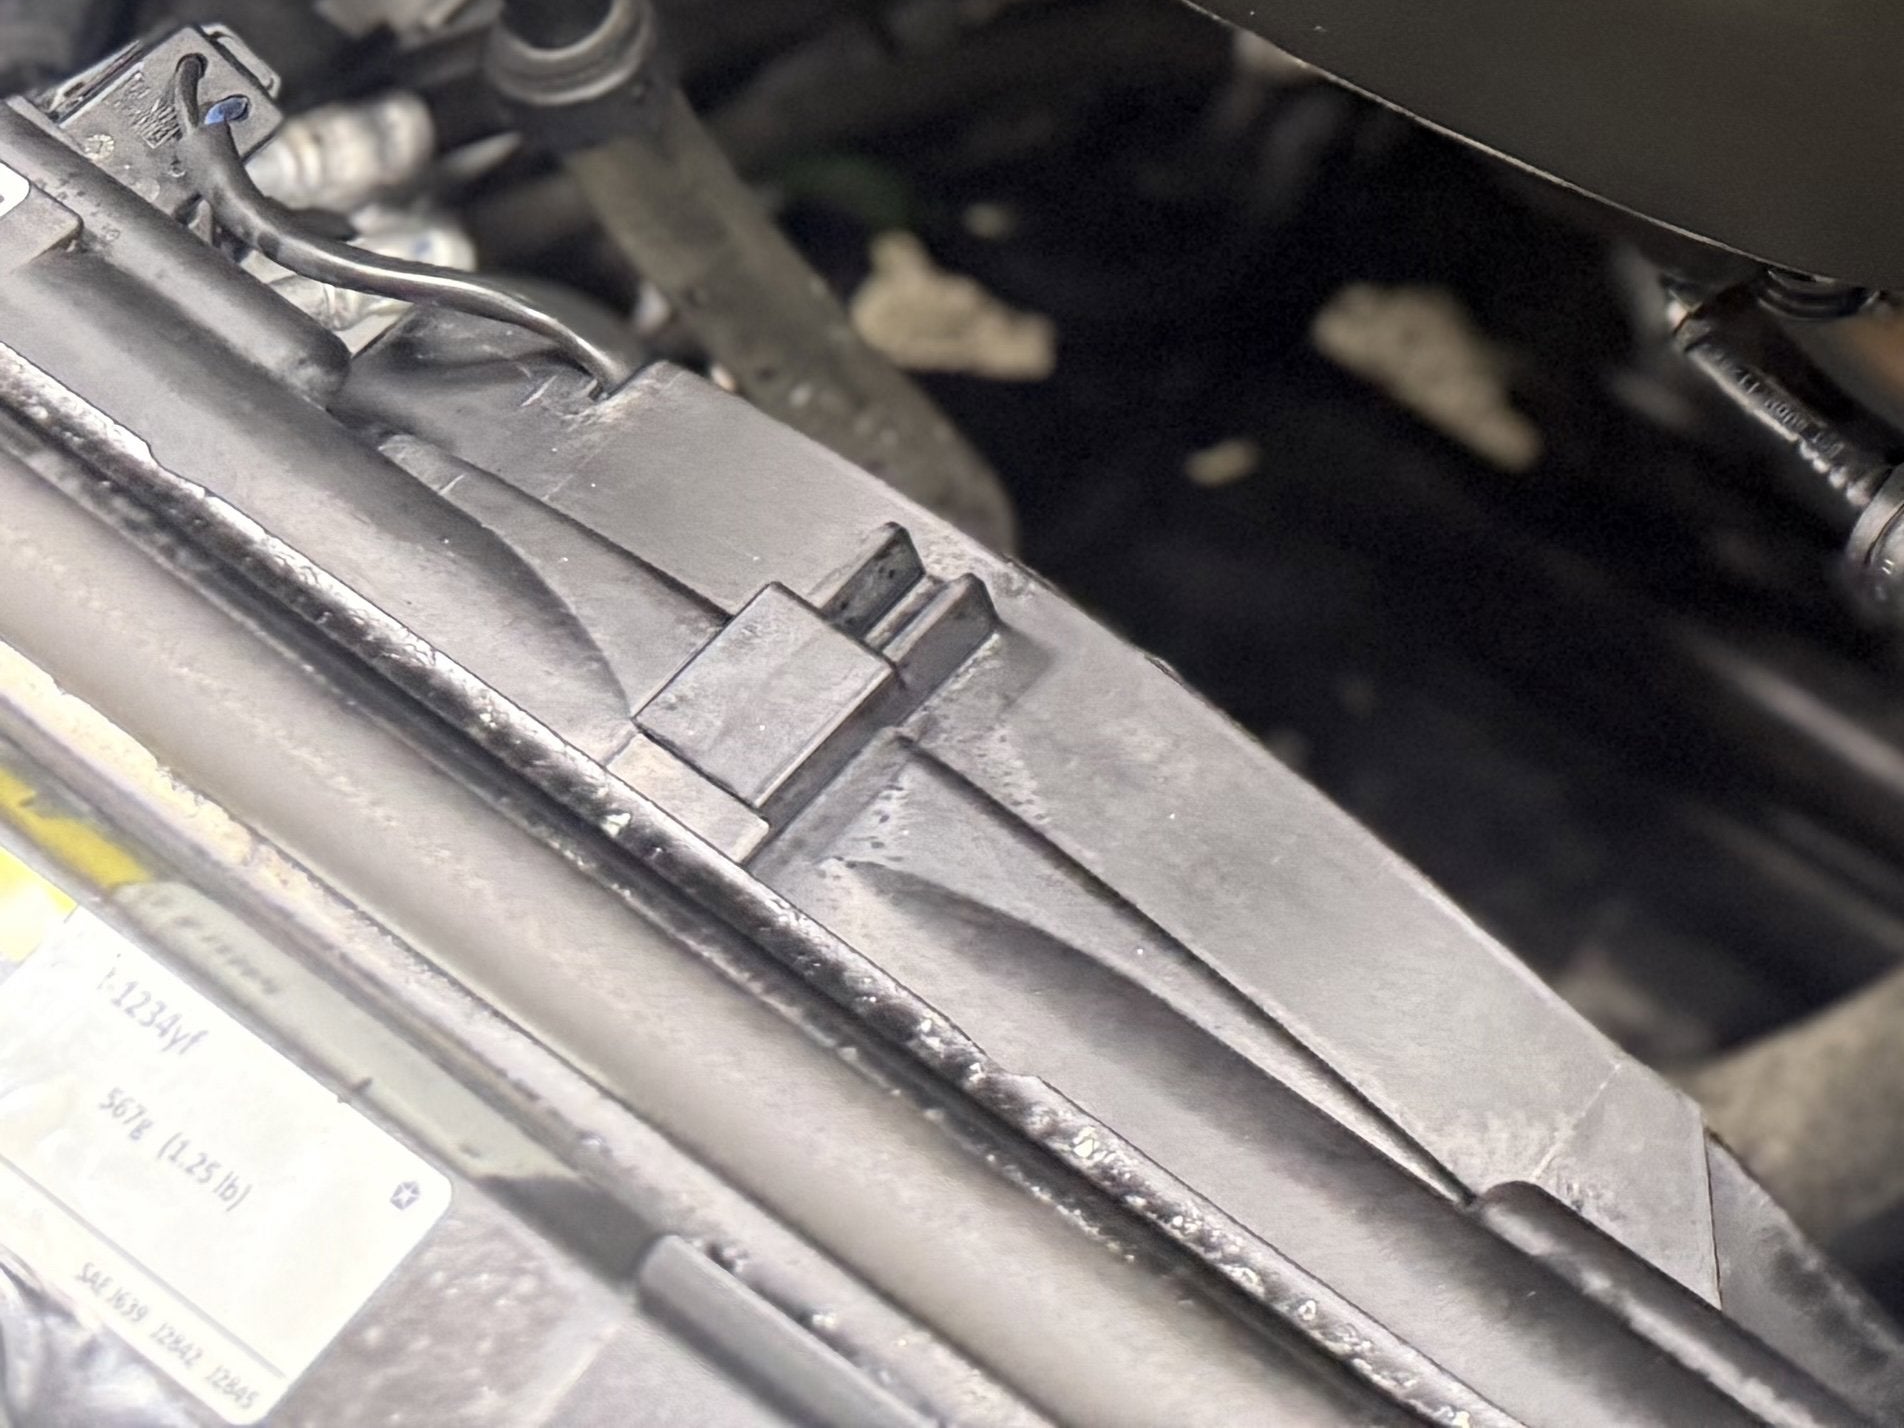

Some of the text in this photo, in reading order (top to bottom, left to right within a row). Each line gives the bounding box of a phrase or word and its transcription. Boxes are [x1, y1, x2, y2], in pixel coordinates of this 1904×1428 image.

[99, 1090, 252, 1213] 567g (1.25 lb)
[74, 1260, 114, 1295] SAE
[150, 1319, 202, 1372] J2842
[206, 1356, 260, 1412] J2845
